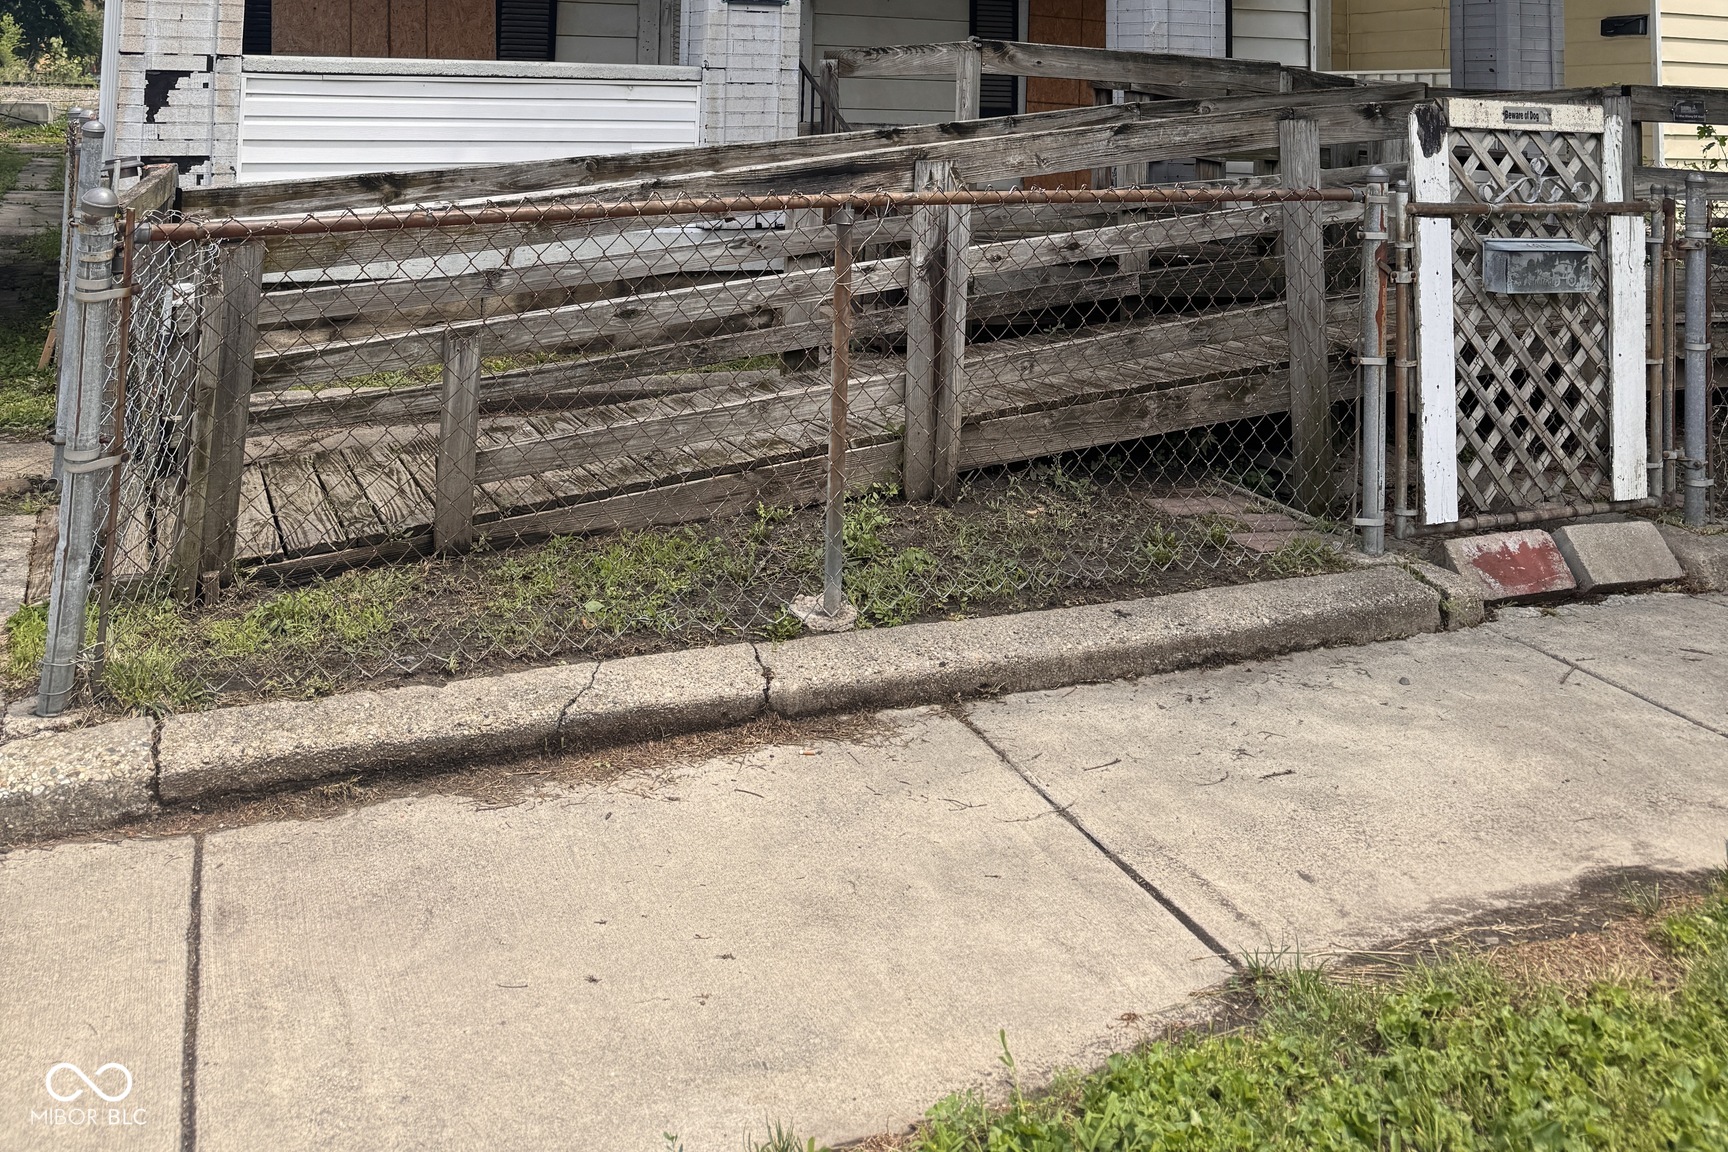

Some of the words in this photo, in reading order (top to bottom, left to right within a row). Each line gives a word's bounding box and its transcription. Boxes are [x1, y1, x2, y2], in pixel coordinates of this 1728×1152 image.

[1504, 110, 1523, 120] Beware
[1524, 110, 1529, 120] of
[1530, 110, 1540, 122] Dog
